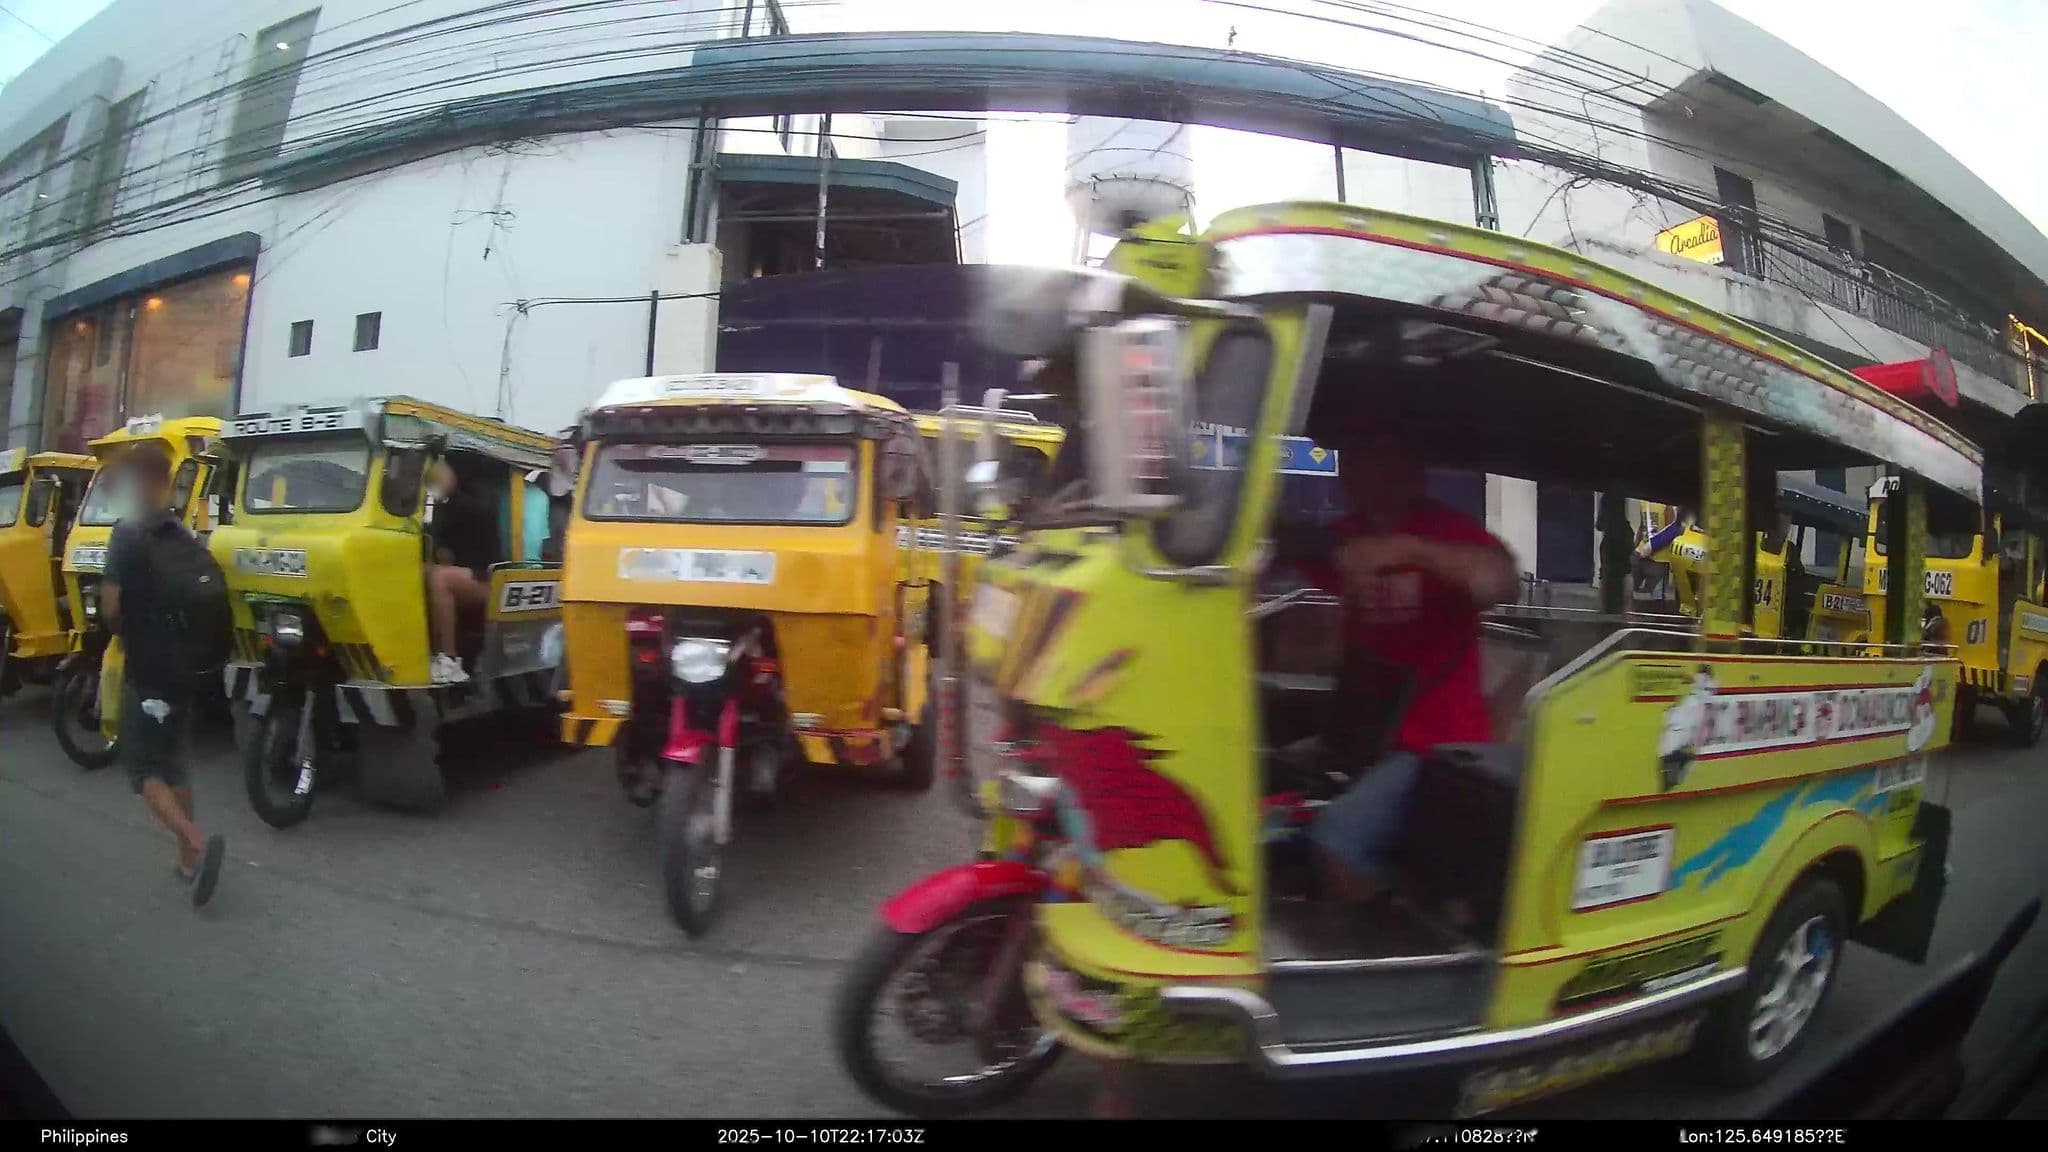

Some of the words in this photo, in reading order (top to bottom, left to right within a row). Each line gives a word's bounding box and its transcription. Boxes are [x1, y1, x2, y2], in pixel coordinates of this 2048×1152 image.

[1671, 223, 1718, 255] Arcadia
[235, 418, 292, 435] ROUTE
[505, 585, 553, 607] B-21
